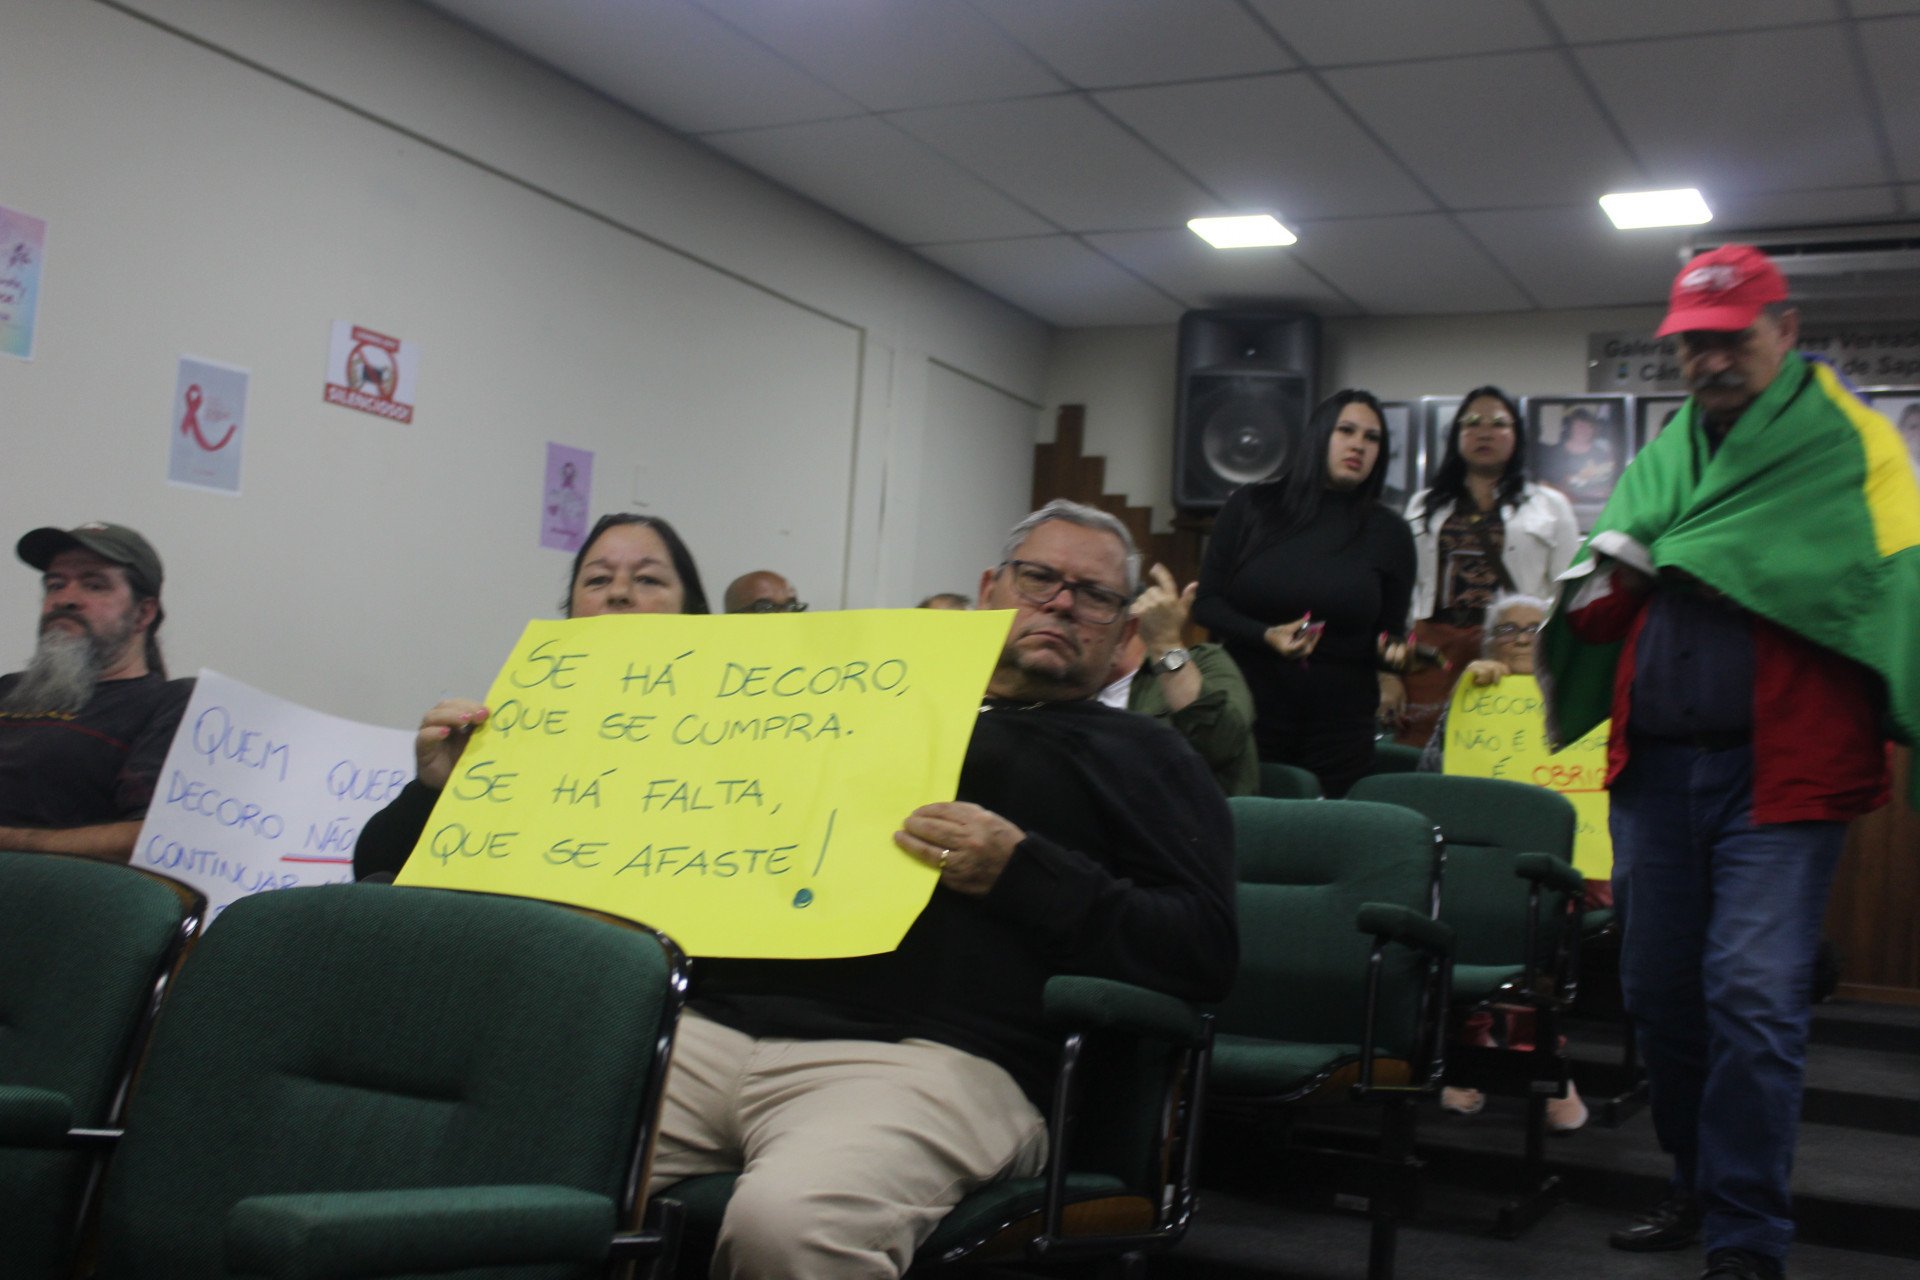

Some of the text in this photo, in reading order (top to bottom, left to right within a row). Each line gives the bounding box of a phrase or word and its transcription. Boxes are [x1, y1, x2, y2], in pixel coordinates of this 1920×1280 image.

[510, 639, 910, 699] SE HÁ DECORO,
[193, 706, 290, 782] QUEM
[491, 699, 854, 746] QUE SE CUMPRA.
[1454, 729, 1502, 752] NÃO
[1512, 730, 1528, 752] É
[166, 769, 285, 840] DECORO
[453, 760, 782, 815] SE HÁ FALTA,
[430, 823, 520, 867] QUE
[542, 838, 610, 869] SE
